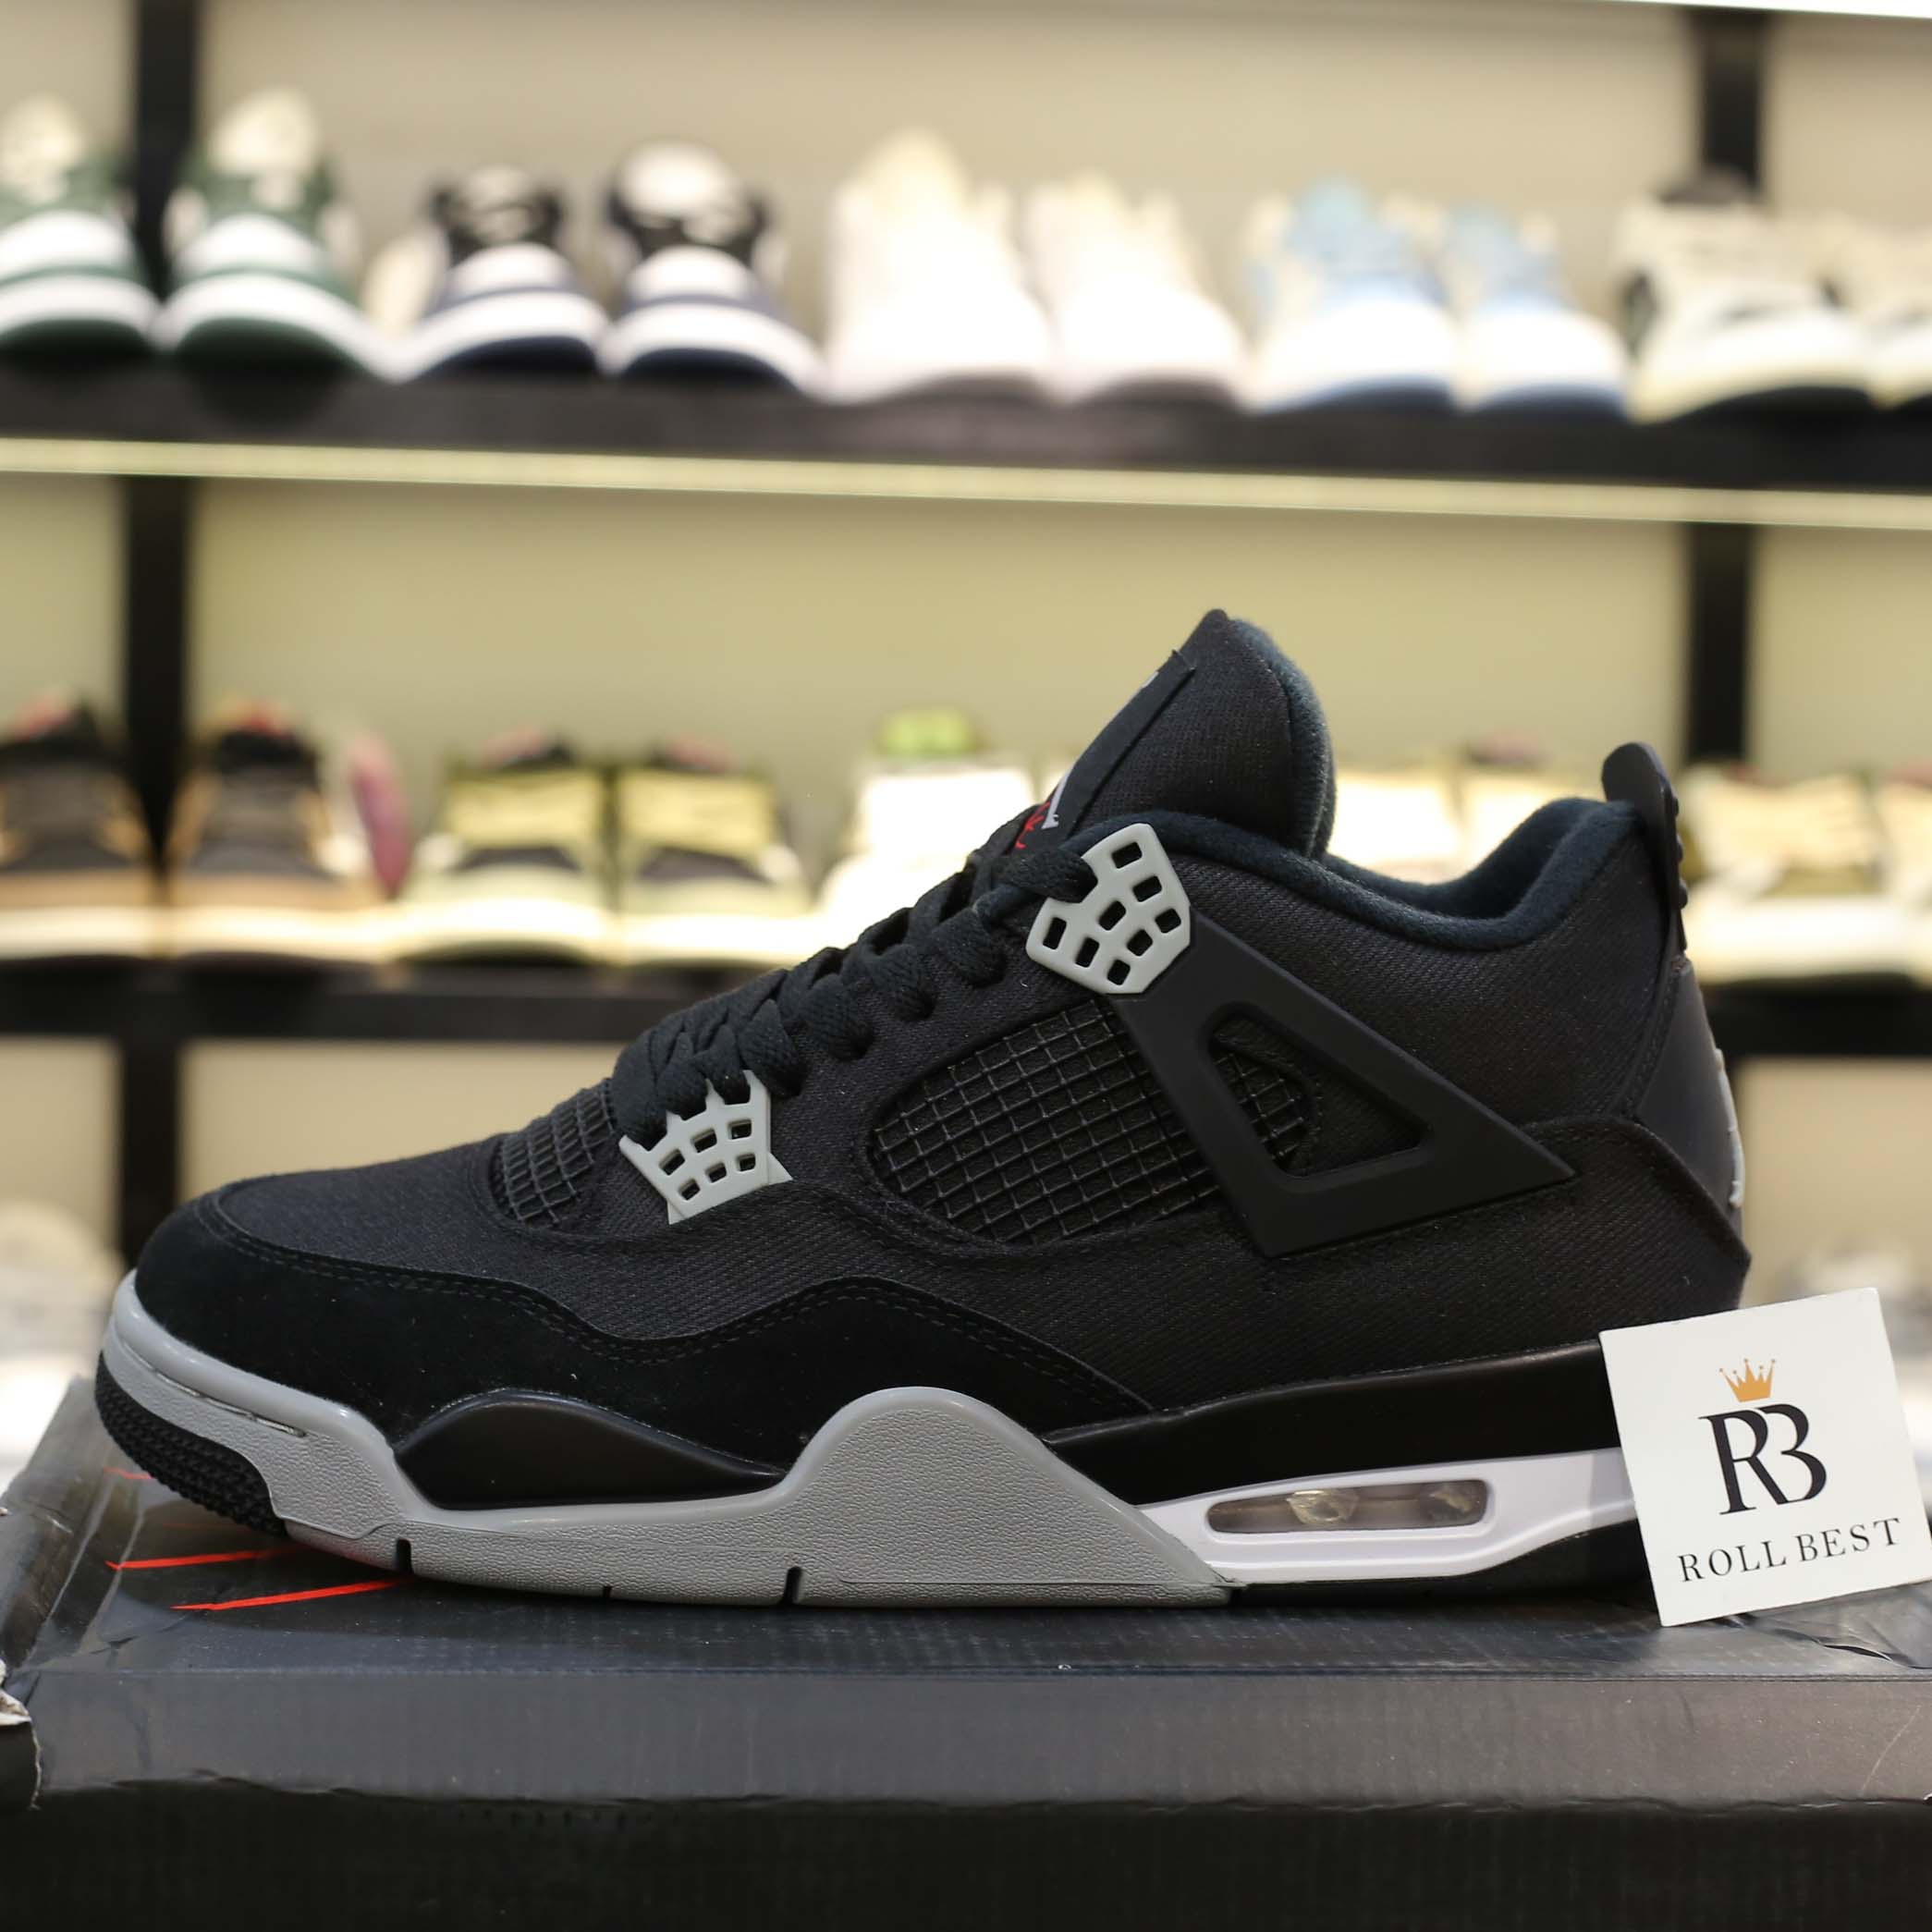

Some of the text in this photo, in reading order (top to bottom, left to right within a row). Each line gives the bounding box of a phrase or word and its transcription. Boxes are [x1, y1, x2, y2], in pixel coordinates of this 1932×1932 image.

[1698, 1403, 1827, 1515] RB
[1678, 1518, 1901, 1582] ROLL BEST
